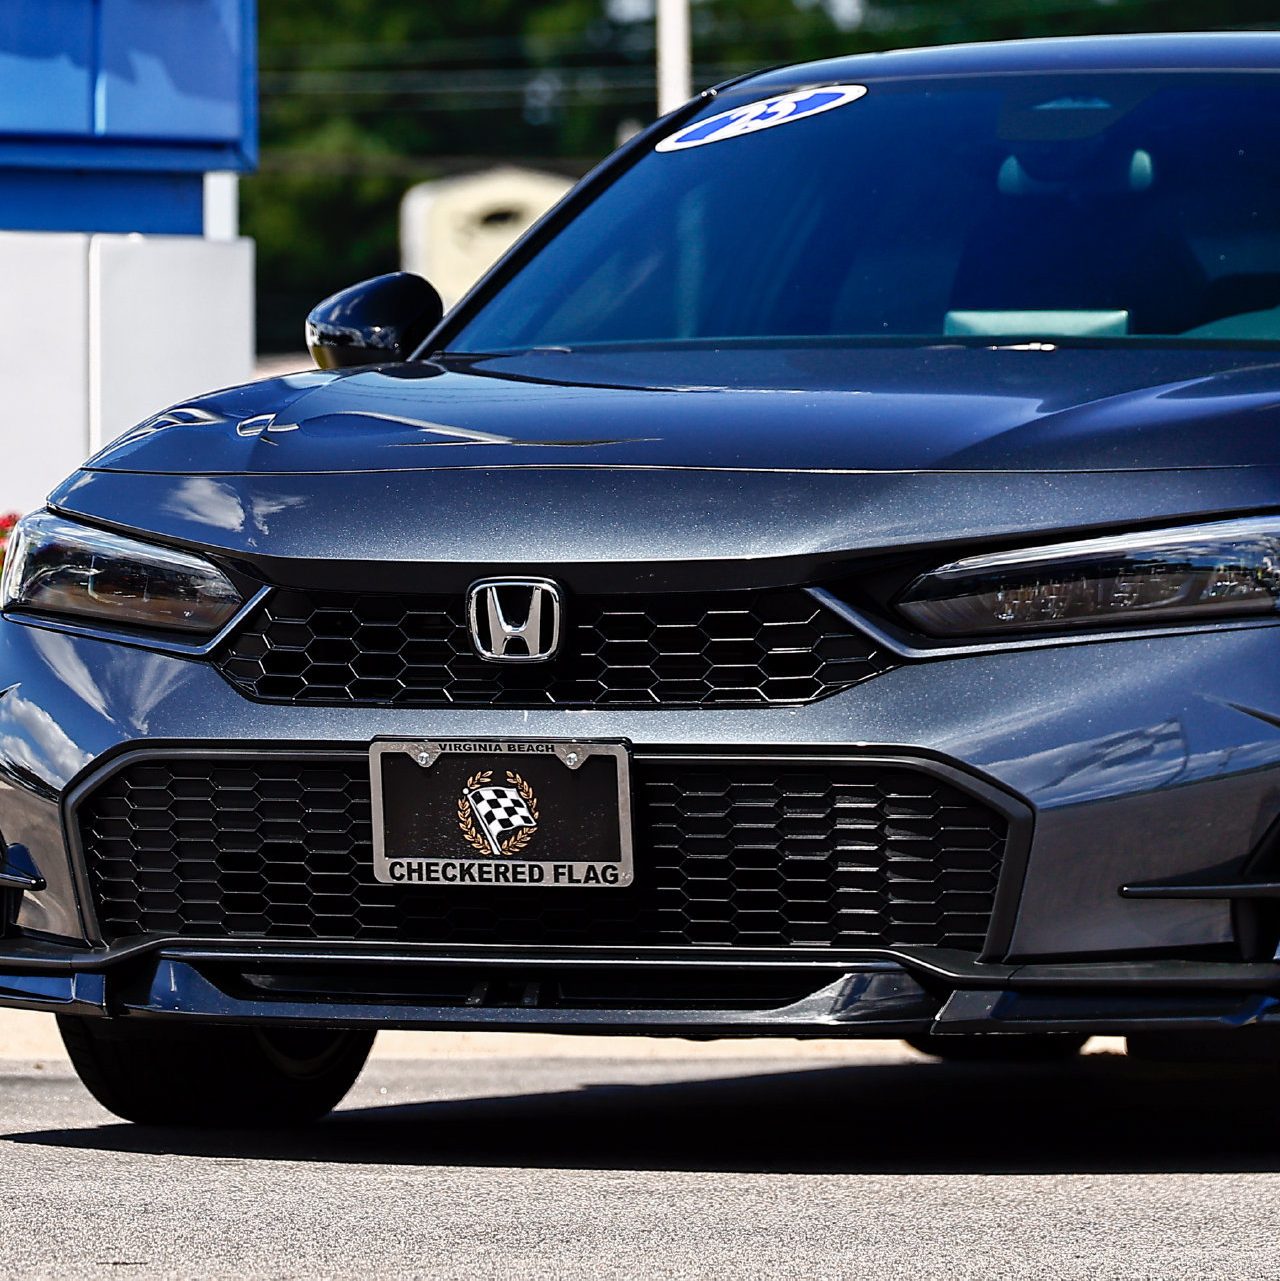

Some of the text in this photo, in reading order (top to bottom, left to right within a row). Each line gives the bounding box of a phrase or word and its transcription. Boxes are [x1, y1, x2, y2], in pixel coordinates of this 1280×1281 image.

[438, 743, 555, 753] VIRGINIA BEACH
[388, 861, 619, 885] CHECKERED FLAG
